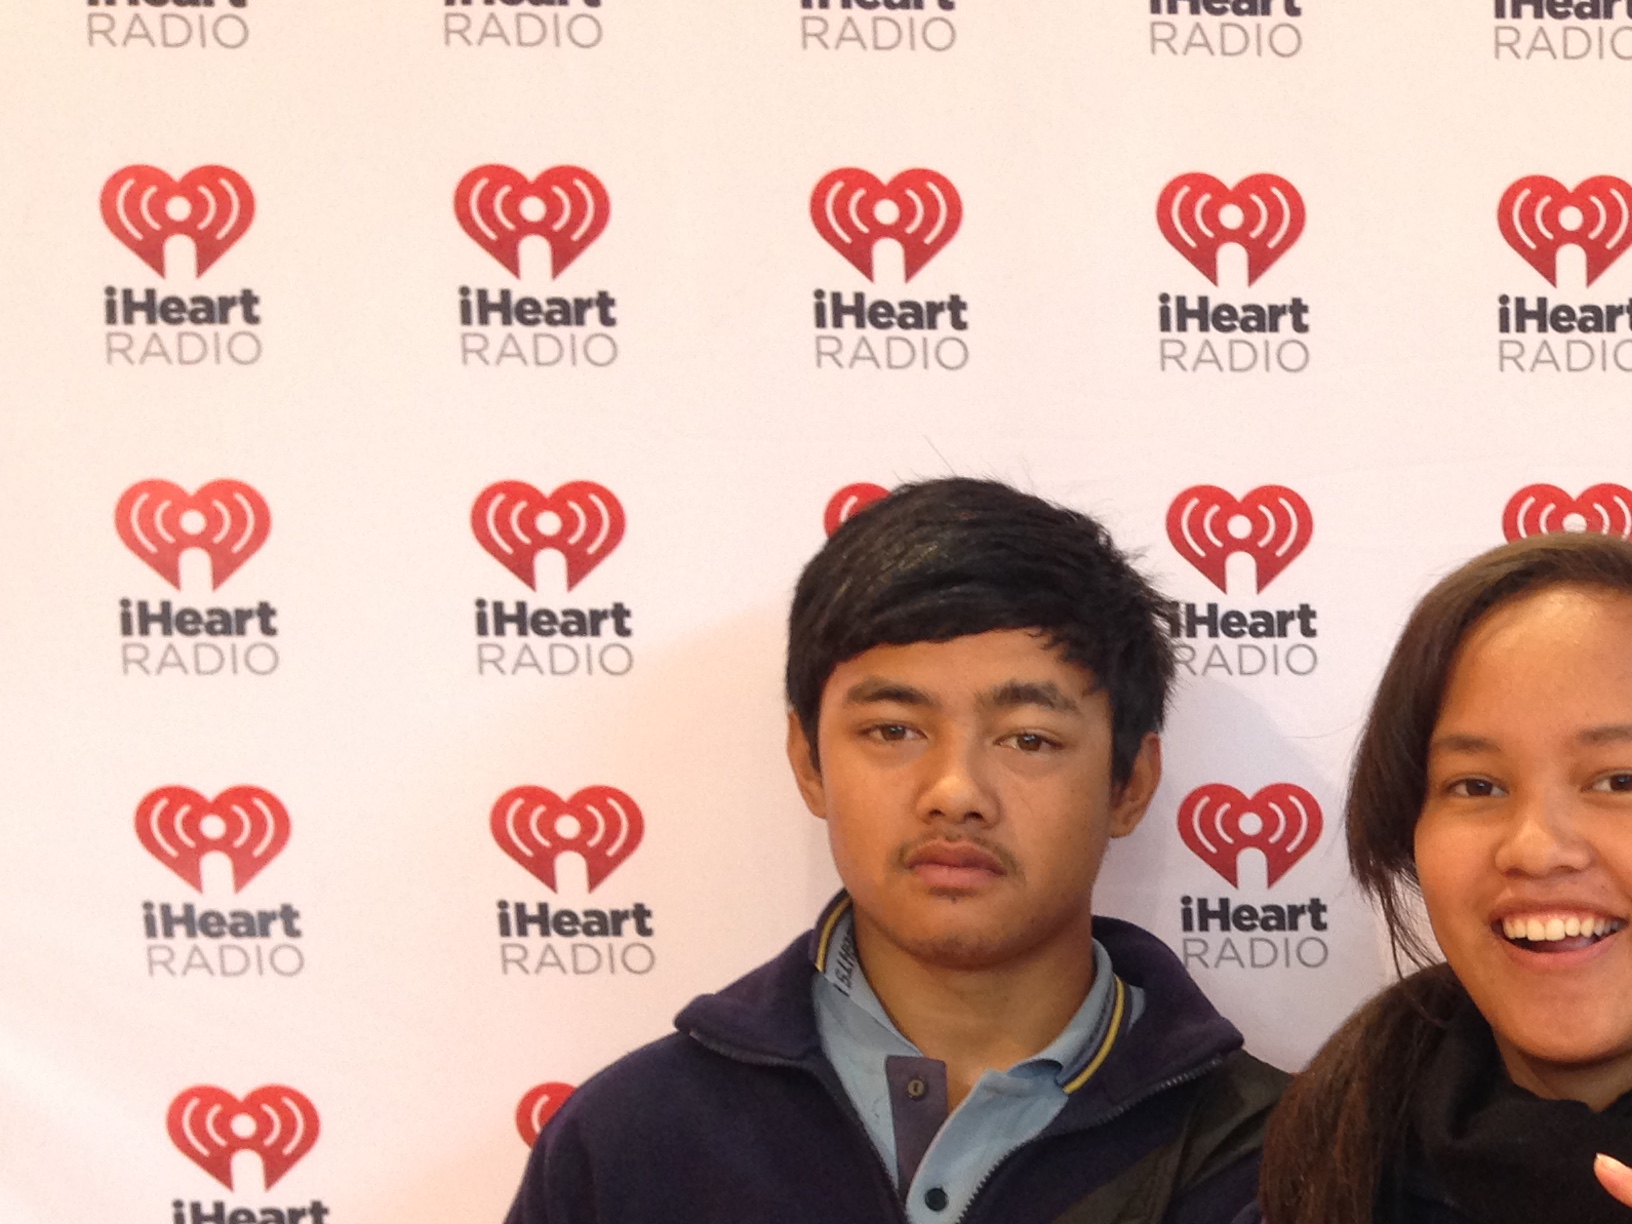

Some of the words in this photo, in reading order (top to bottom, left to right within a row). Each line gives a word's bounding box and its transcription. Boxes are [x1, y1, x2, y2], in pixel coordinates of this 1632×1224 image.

[88, 13, 250, 50] RADIO
[445, 13, 604, 50] RADIO
[802, 16, 958, 53] RADIO
[1151, 22, 1303, 59] RADIO
[104, 286, 263, 328] iHeart
[458, 285, 619, 329] iHeart
[813, 289, 970, 333] iHeart
[1159, 293, 1311, 335] iHeart
[107, 332, 263, 366] RADIO
[462, 333, 619, 368] RADIO
[816, 336, 970, 372] RADIO
[1161, 339, 1311, 374] RADIO
[119, 597, 280, 639] iHeart
[475, 598, 635, 640] iHeart
[122, 643, 281, 677] RADIO
[478, 644, 635, 677] RADIO
[142, 900, 304, 941] iHeart
[497, 899, 656, 939] iHeart
[1181, 896, 1329, 934] iHeart
[148, 945, 306, 978] RADIO
[501, 943, 657, 976] RADIO
[1182, 936, 1329, 969] RADIO
